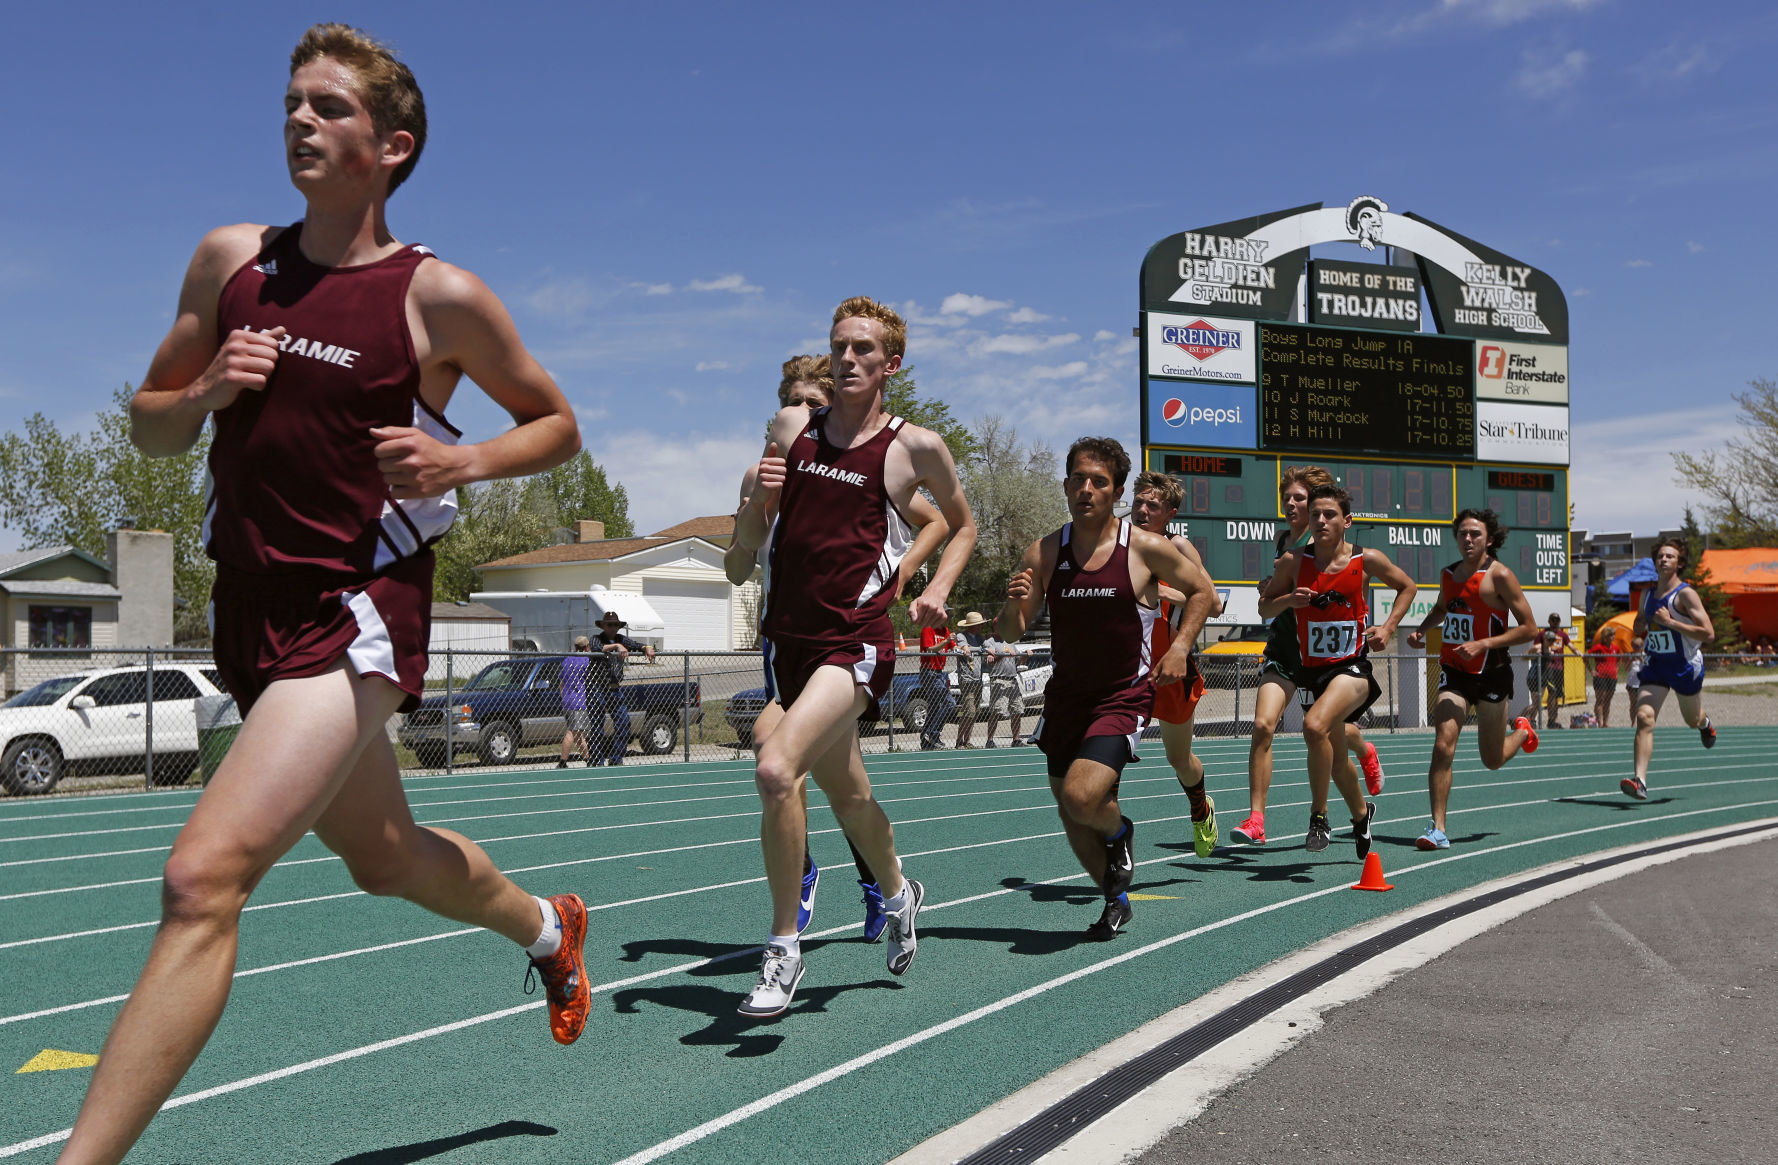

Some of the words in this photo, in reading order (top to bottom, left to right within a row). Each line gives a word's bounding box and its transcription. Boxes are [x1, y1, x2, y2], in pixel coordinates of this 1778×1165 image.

[1185, 232, 1269, 263] HARRY
[1179, 257, 1276, 289] GELDIEN
[1319, 269, 1360, 287] HOME
[1364, 274, 1382, 289] OF
[1386, 276, 1415, 292] THE
[1465, 262, 1531, 288] KELLY
[1192, 284, 1262, 305] STADIUM
[1460, 285, 1537, 312] WALSH
[1317, 292, 1418, 321] TROJANS
[1455, 308, 1488, 326] HIGH
[1491, 311, 1544, 330] SCHOOL
[243, 325, 361, 369] RAMIE
[1163, 327, 1240, 349] GREINER
[1261, 328, 1298, 345] Boys
[1307, 332, 1343, 349] Long
[1352, 336, 1387, 352] Jump
[1188, 346, 1201, 354] EST.
[1508, 353, 1537, 368] First
[1161, 364, 1243, 379] GreinerMotors.com
[1262, 347, 1335, 367] Complete
[1343, 353, 1405, 372] Results
[1412, 358, 1464, 376] Finals
[1262, 373, 1271, 386] 9
[1280, 374, 1289, 387] T
[1298, 375, 1361, 392] Mueller
[1398, 382, 1465, 399] 18-04.50
[1506, 367, 1567, 384] Interstate
[1505, 381, 1531, 396] Bank
[1265, 390, 1281, 403] 10
[1289, 392, 1299, 404] J
[1307, 393, 1351, 408] Roark
[1407, 399, 1473, 415] 17-11.50
[1190, 406, 1240, 427] pepsi
[1265, 406, 1278, 419] 11
[1289, 408, 1299, 421] S
[1307, 409, 1369, 425] Murdock
[1407, 415, 1473, 431] 17-10.75
[1265, 423, 1281, 436] 12
[1290, 424, 1299, 437] H
[1308, 425, 1342, 440] Hill
[1407, 431, 1473, 447] 17-10.25
[1479, 419, 1507, 438] Star
[1513, 421, 1568, 442] Tribune
[797, 459, 868, 487] LARAMIE
[1181, 455, 1227, 473] HOME
[1498, 471, 1545, 489] GUEST
[1226, 521, 1275, 541] DOWN
[1388, 526, 1420, 545] BALL
[1423, 528, 1441, 546] ON
[1536, 533, 1562, 549] TIME
[1536, 550, 1566, 566] OUTS
[1536, 568, 1562, 584] LEFT
[1061, 587, 1117, 598] LARAMIE
[1311, 626, 1354, 654] 237
[1443, 617, 1470, 642] 239
